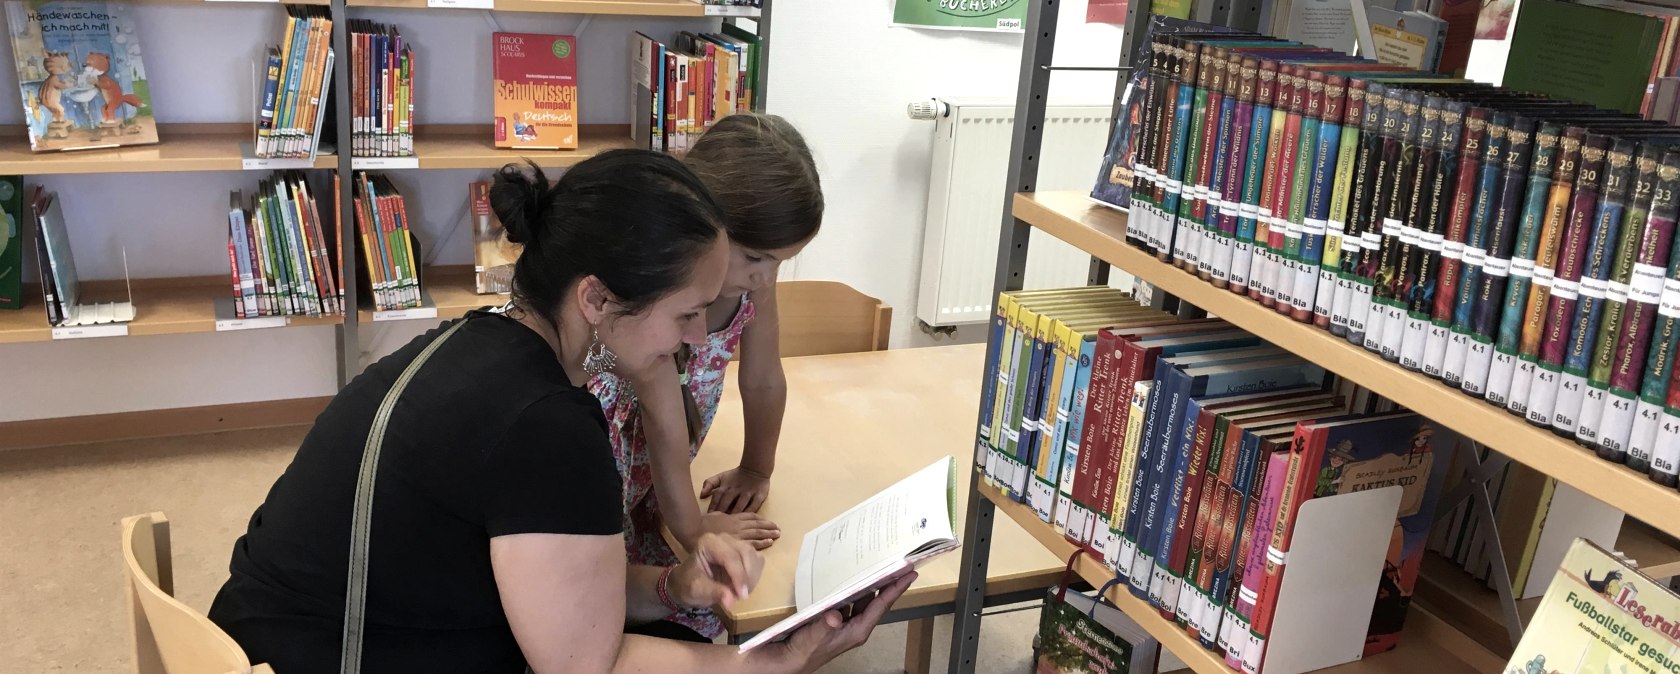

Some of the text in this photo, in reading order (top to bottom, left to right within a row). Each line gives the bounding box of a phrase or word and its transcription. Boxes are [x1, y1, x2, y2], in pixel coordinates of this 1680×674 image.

[27, 11, 109, 22] Händewaschen
[59, 22, 89, 31] mach
[500, 36, 524, 44] BROCK
[1153, 59, 1158, 67] 5
[1175, 64, 1180, 72] 6
[1229, 80, 1236, 89] 11
[499, 80, 577, 102] Schulwissen
[1241, 86, 1250, 94] 12
[1261, 88, 1268, 97] 13
[1279, 92, 1287, 101] 14
[1293, 96, 1301, 104] 15
[535, 100, 571, 110] kompakt
[1309, 100, 1318, 108] 16
[1327, 104, 1336, 113] 17
[524, 111, 571, 121] Deutsch
[1350, 108, 1358, 116] 18
[1367, 113, 1376, 122] 19
[1384, 118, 1394, 127] 20
[1222, 108, 1231, 139] Spinnen
[1401, 122, 1410, 131] 21
[1422, 128, 1432, 137] 22
[1441, 132, 1452, 142] 24
[1466, 139, 1478, 149] 25
[1487, 146, 1499, 156] 26
[1507, 152, 1519, 162] 27
[1536, 155, 1548, 165] 28
[1559, 160, 1574, 171] 29
[1581, 170, 1596, 181] 30
[1608, 175, 1620, 186] 31
[1636, 181, 1651, 193] 32
[1656, 189, 1671, 201] 33
[1236, 241, 1247, 251] 4.1
[1565, 210, 1583, 278] Raubschrecke
[1293, 298, 1307, 308] Bla
[1433, 328, 1444, 338] 4.1
[1472, 344, 1484, 353] 4.1
[1654, 338, 1669, 376] Modrik,
[1093, 355, 1102, 380] kleine
[1425, 365, 1439, 375] Bla
[1521, 364, 1535, 373] 4.1
[1094, 351, 1110, 413] Ritter Trenk
[1539, 372, 1553, 382] 4.1
[1464, 381, 1479, 392] Bla
[1564, 381, 1578, 392] 4.1
[1489, 392, 1504, 403] Bla
[1588, 390, 1602, 400] 4.1
[1112, 405, 1122, 435] Ritter
[1118, 375, 1128, 403] Trenk
[1511, 402, 1527, 410] Bla
[1613, 400, 1629, 411] 4.1
[1530, 411, 1546, 423] Bla
[1556, 414, 1572, 426] Bla
[1642, 410, 1657, 421] 4.1
[1579, 426, 1595, 438] Bla
[1664, 422, 1679, 434] 4.1
[1081, 422, 1095, 474] Kirsten Boie
[1131, 378, 1162, 514] Kirsten Boie Seeräubermoses
[1603, 438, 1620, 450] Bla
[1631, 447, 1648, 460] Bla
[1145, 390, 1179, 529] Kirsten Boie Seeräubermoses
[1655, 458, 1672, 470] Bla
[1178, 424, 1207, 529] Kirsten Boie Wieder Nix!
[1161, 417, 1195, 559] Kirsten Boie Verflixt ein Nix!
[1039, 508, 1048, 517] Boe
[1068, 529, 1078, 538] Boi
[1094, 539, 1104, 549] Boi
[1132, 576, 1142, 587] Boi
[1167, 575, 1175, 584] 4.1
[1161, 601, 1172, 611] Boi
[1617, 587, 1680, 640] Leserab
[1235, 620, 1246, 629] 4.1
[1201, 627, 1211, 637] Bre
[1566, 591, 1680, 674] Fußballstar gesuc
[1250, 636, 1258, 645] 4.1
[1578, 622, 1601, 639] Andreas
[1624, 652, 1635, 663] und
[1230, 647, 1240, 657] Bri
[1242, 660, 1255, 672] Bux
